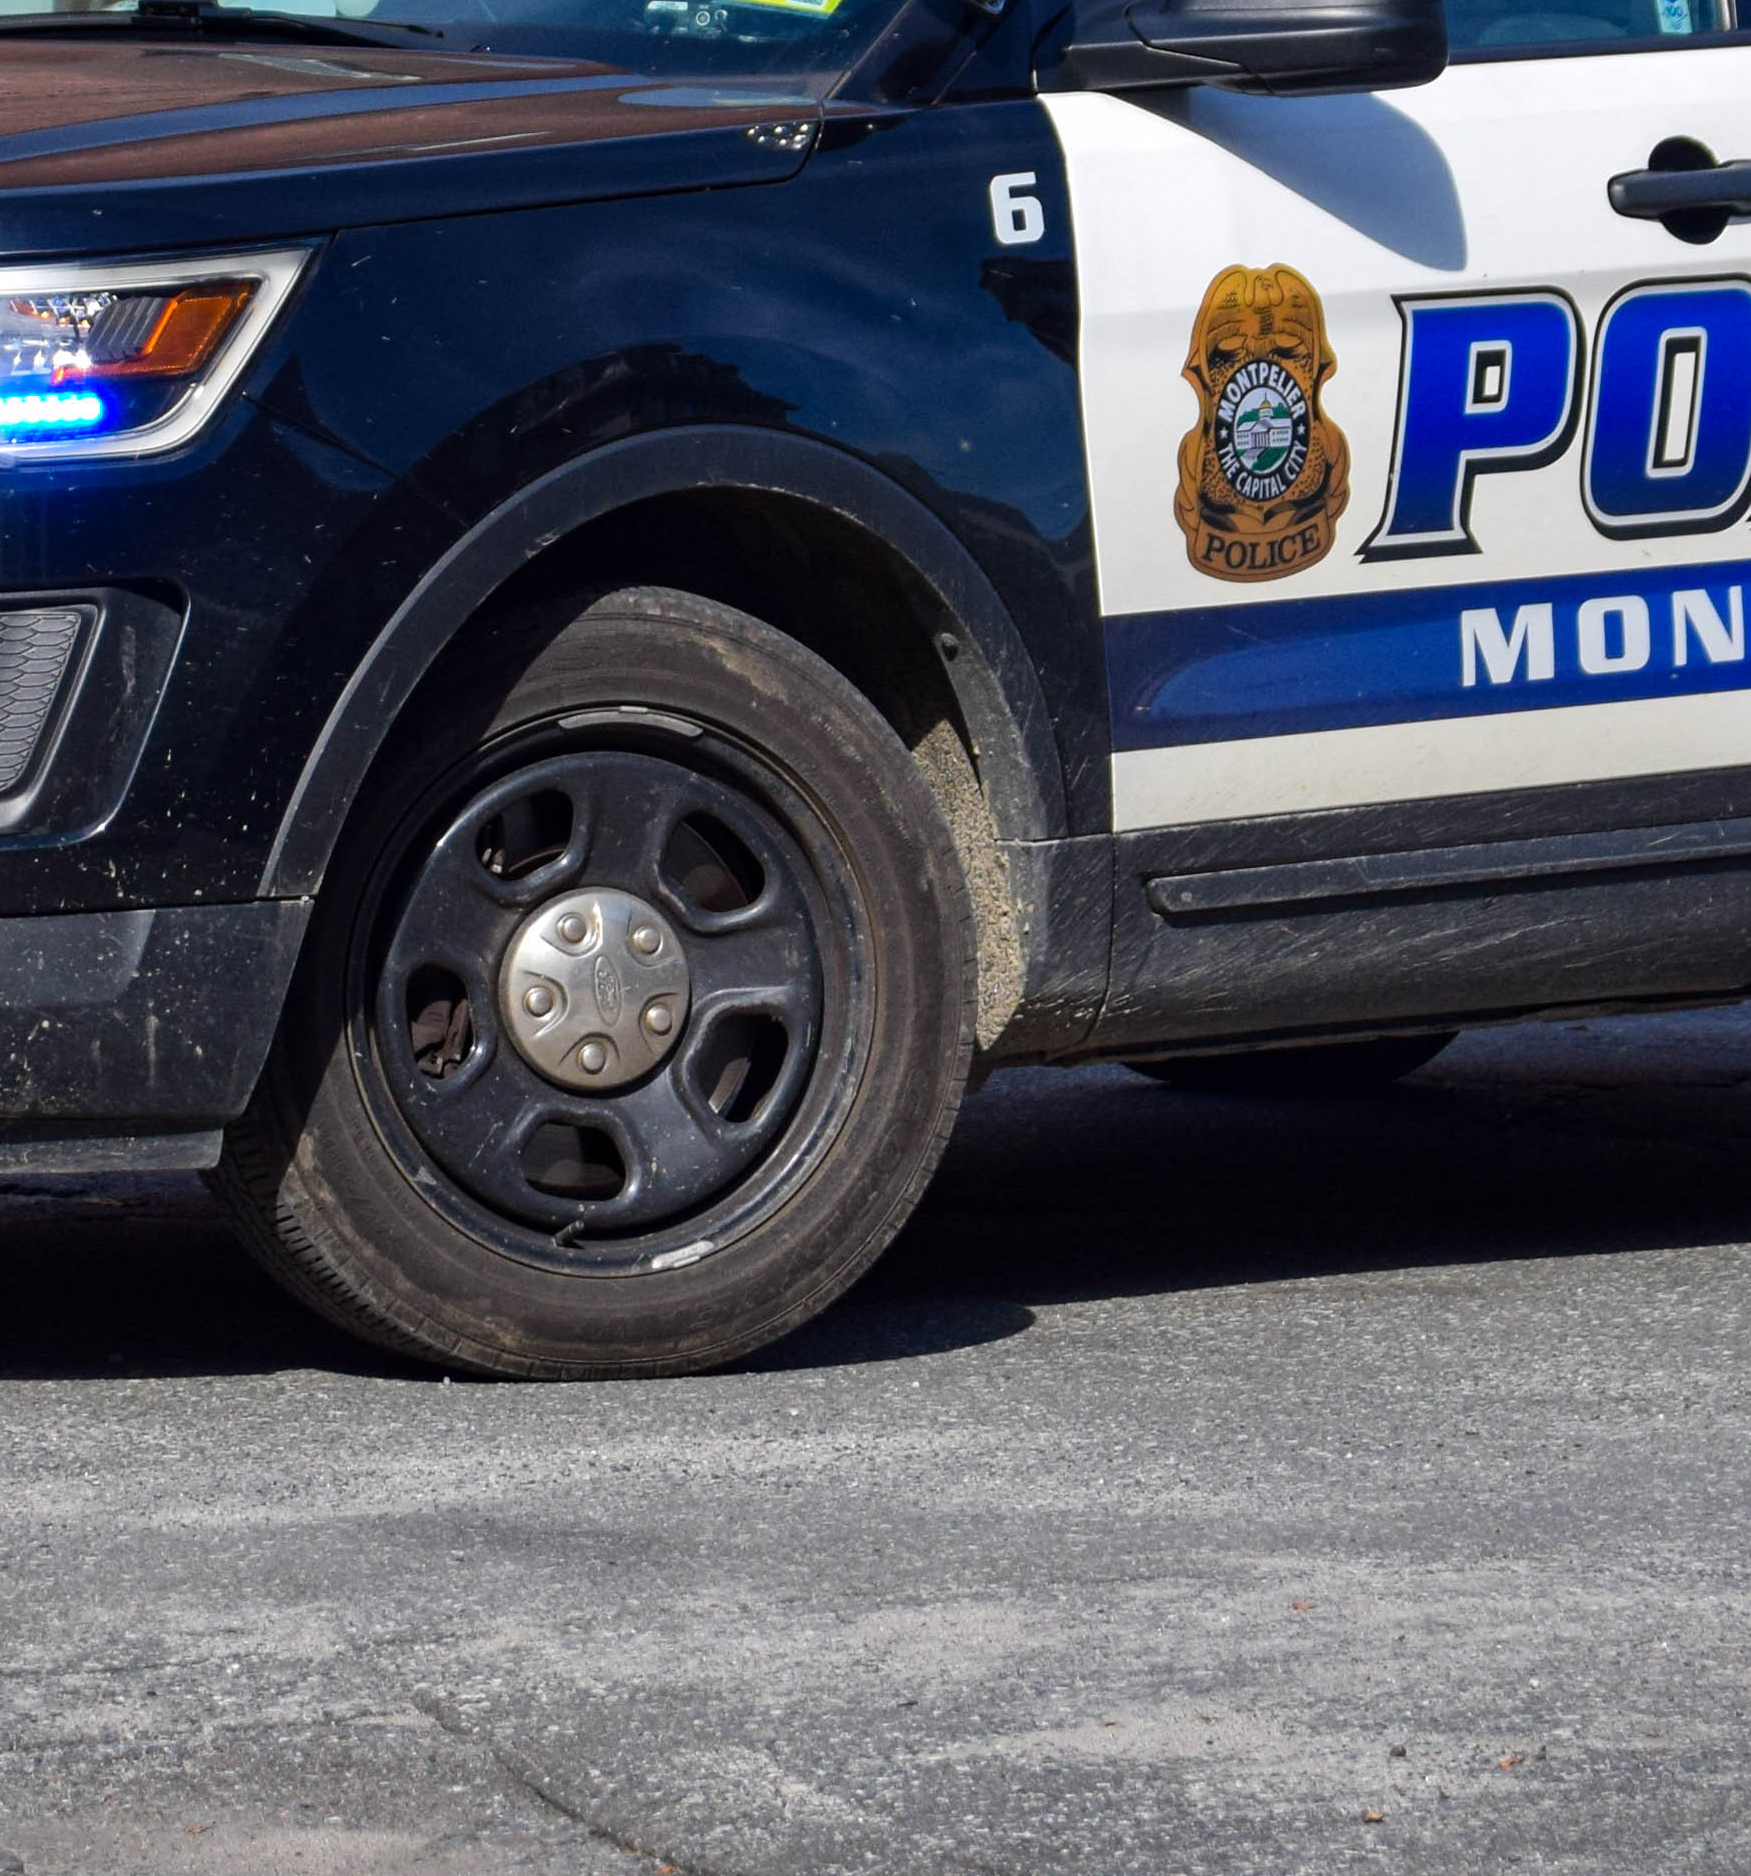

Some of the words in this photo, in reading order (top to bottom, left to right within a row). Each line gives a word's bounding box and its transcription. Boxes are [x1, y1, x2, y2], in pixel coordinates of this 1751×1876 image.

[990, 170, 1045, 245] 6
[1218, 362, 1307, 423] MONTPELIER
[1218, 443, 1240, 478] THE
[1235, 470, 1288, 500] CAPITAL
[1285, 441, 1310, 482] CITY
[1203, 526, 1321, 569] POLICE
